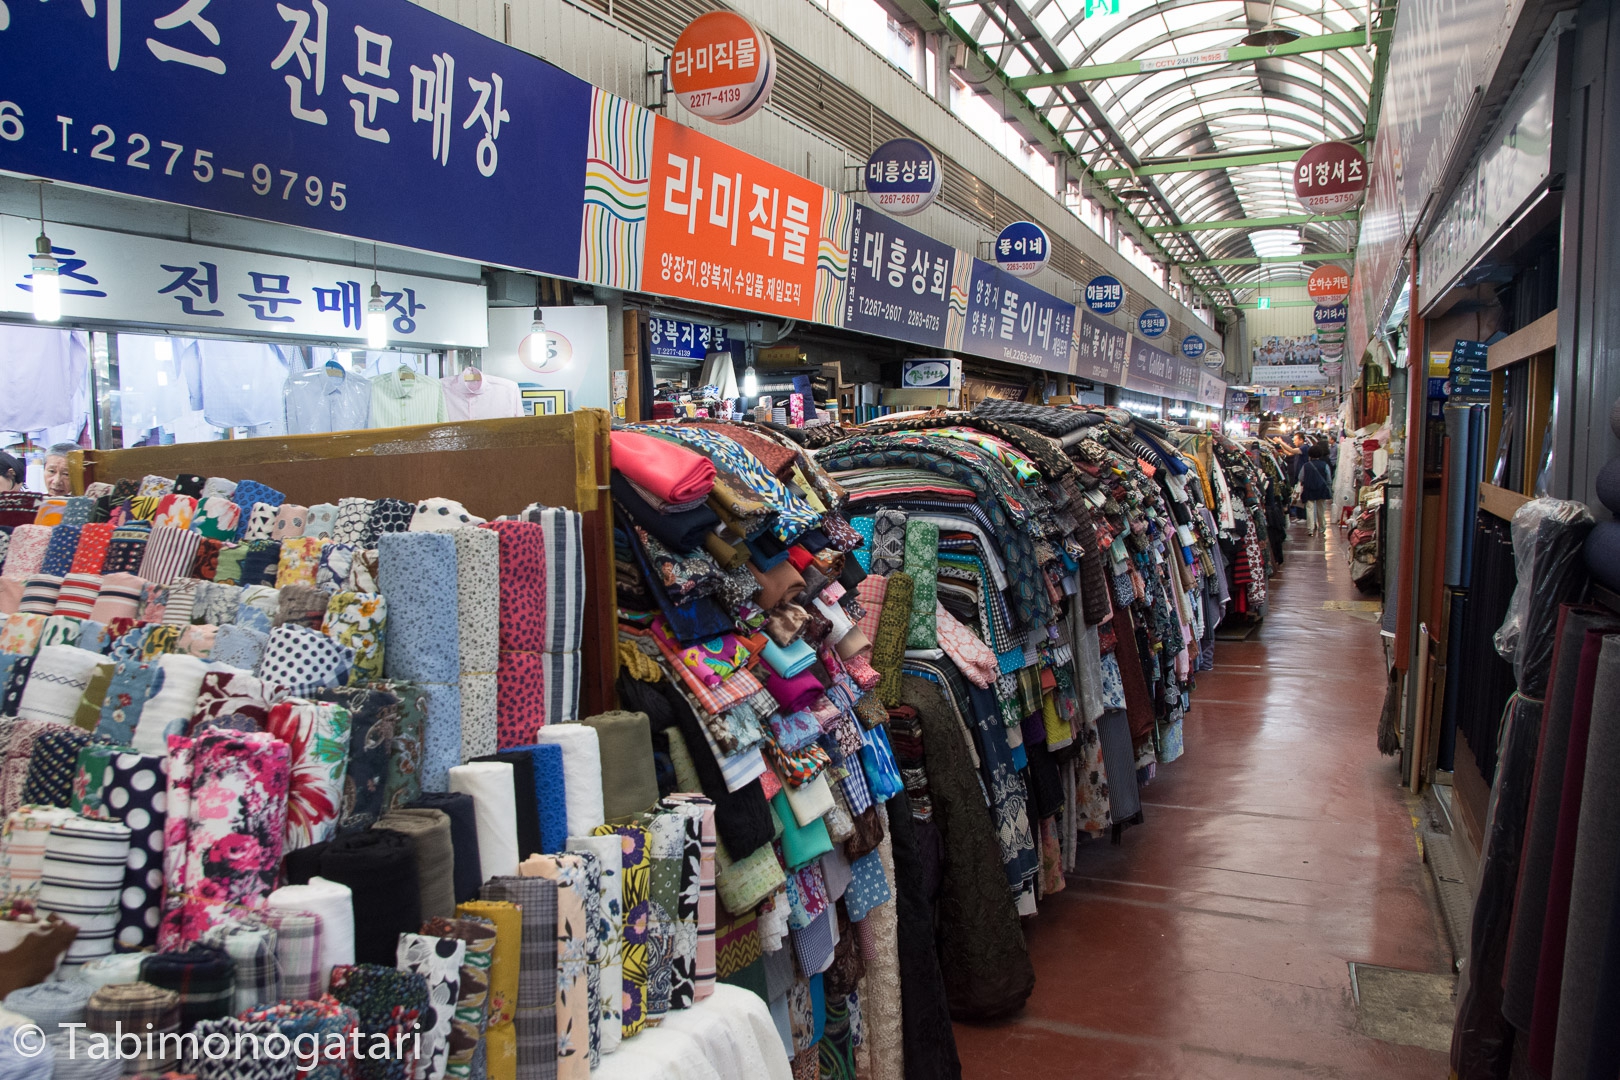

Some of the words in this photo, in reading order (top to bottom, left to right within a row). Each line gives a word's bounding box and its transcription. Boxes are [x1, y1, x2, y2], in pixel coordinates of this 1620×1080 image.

[675, 37, 757, 77] 라미직물
[1155, 60, 1176, 68] CCTV
[690, 88, 741, 108] 2277-4139
[869, 160, 933, 184] 대흥상회
[1298, 158, 1363, 188] 의창셔츠
[663, 152, 811, 265] 라미직물
[879, 194, 920, 204] 2267-2607
[1309, 193, 1355, 206] 2265-3750
[862, 231, 949, 302] 대흥상회
[1006, 262, 1036, 271] 2263-3007
[975, 279, 1000, 310] 양장지
[1087, 284, 1121, 301] 하늘커텐
[1308, 275, 1348, 292] 은하수커텐
[158, 261, 426, 335] 전문매장
[907, 309, 940, 332] 2263-6725
[971, 310, 996, 340] 양복지
[1000, 289, 1053, 351] 똘이네
[1314, 307, 1346, 320] 경기라사
[656, 347, 691, 357] T.2277-4139
